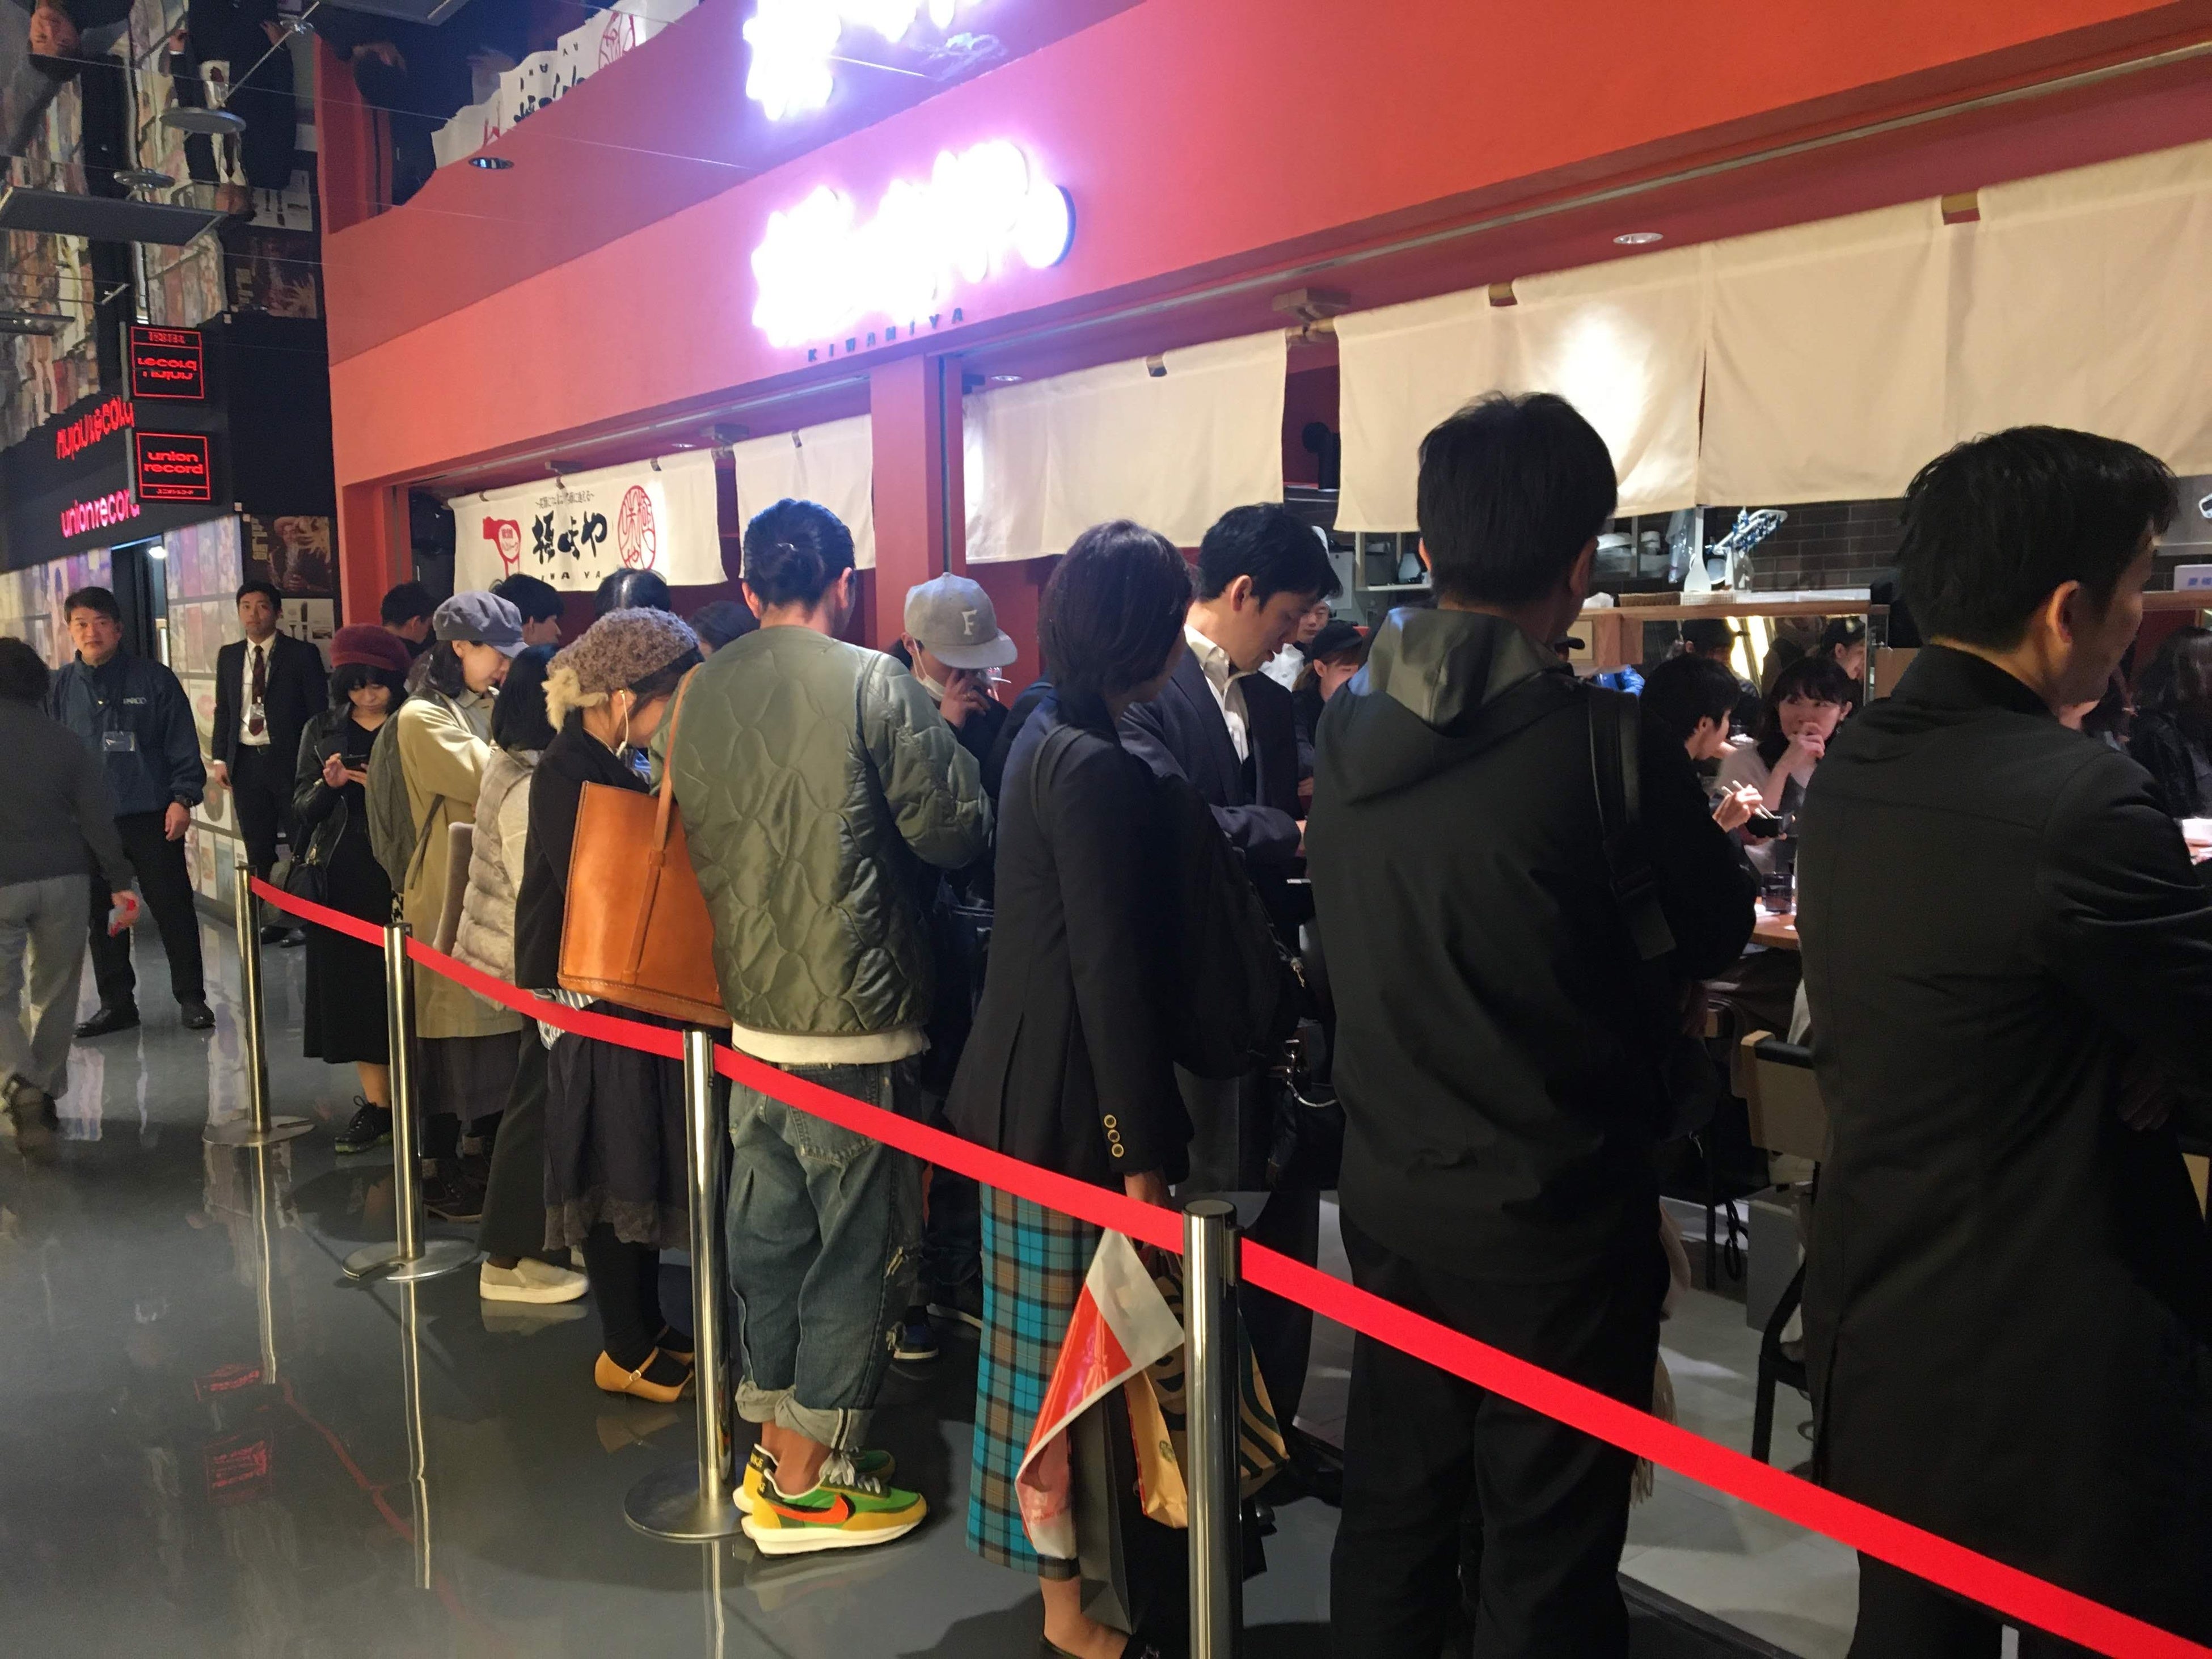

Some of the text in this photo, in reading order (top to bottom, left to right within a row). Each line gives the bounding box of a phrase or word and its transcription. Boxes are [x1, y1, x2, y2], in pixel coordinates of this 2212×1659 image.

[808, 307, 963, 362] KIWAMIYA
[147, 450, 199, 462] union
[143, 463, 204, 474] record
[961, 609, 977, 635] F
